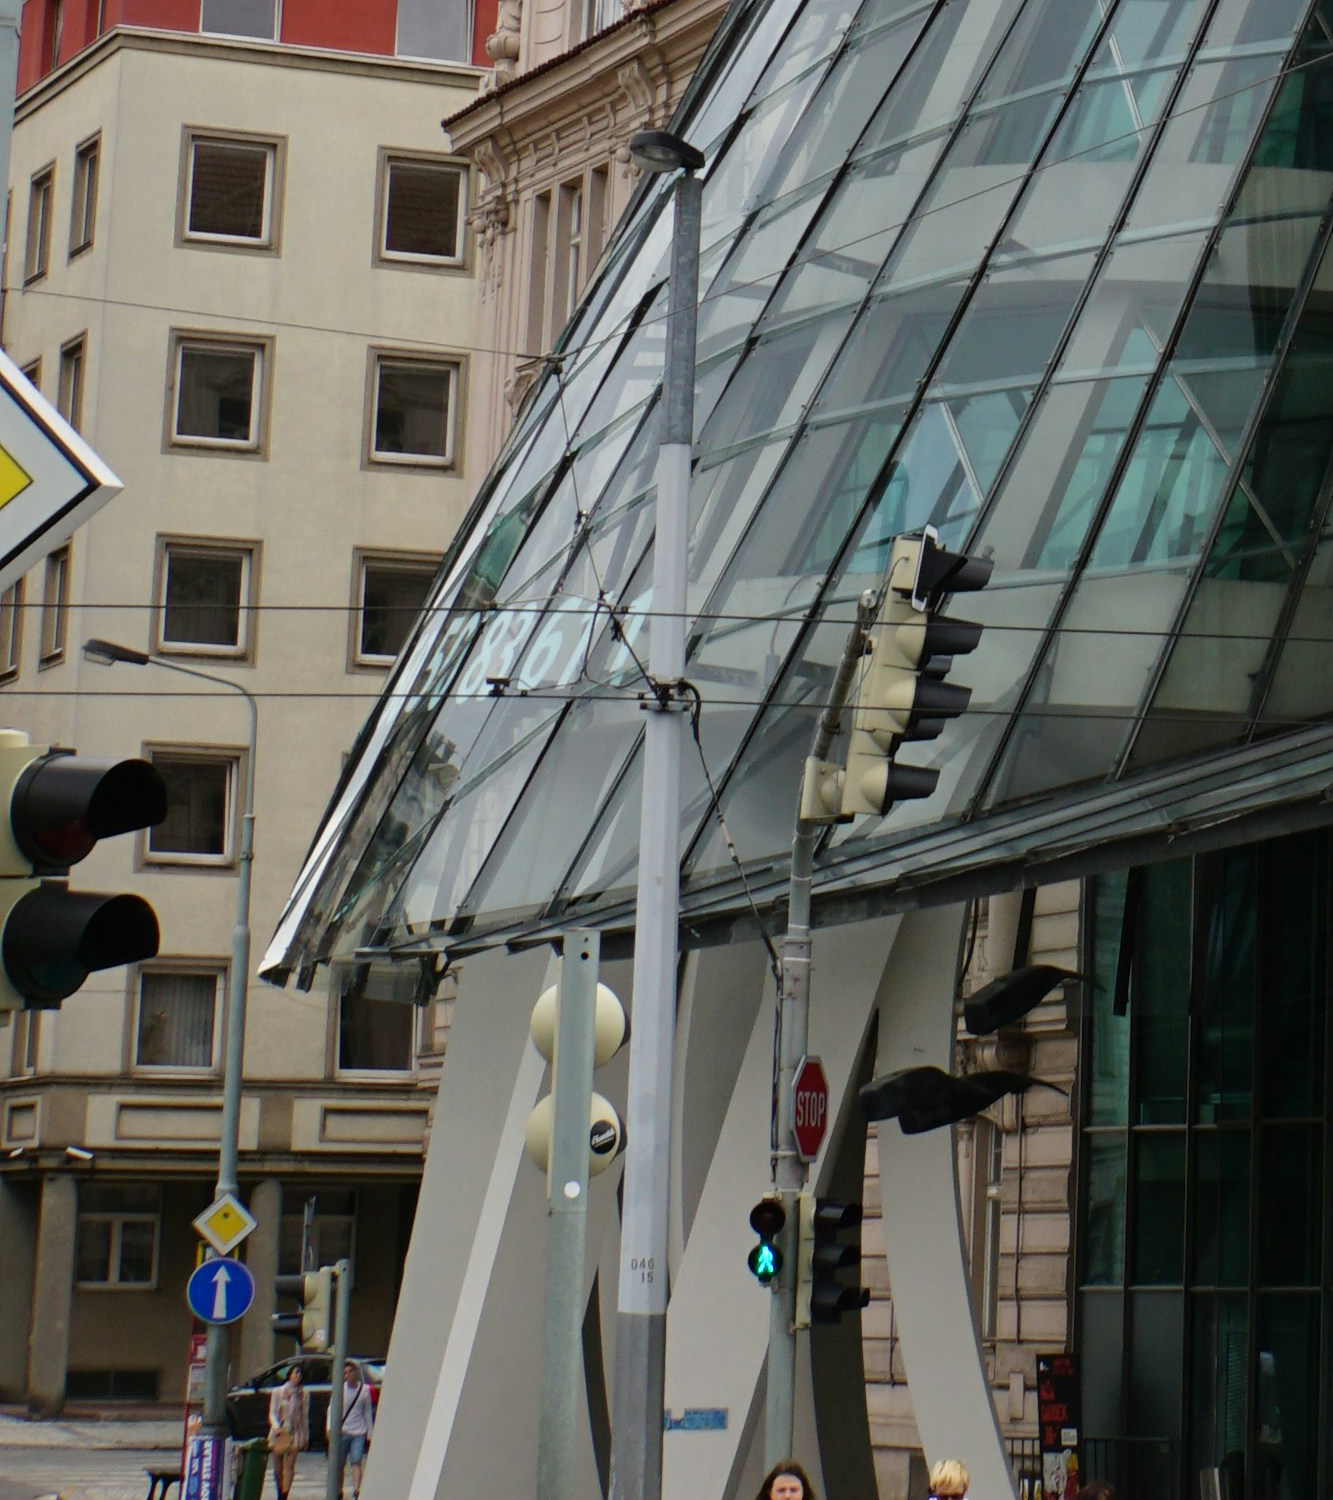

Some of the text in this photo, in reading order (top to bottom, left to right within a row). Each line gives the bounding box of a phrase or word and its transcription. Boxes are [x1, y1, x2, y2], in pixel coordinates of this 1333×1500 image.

[797, 1091, 825, 1127] STOP
[631, 1257, 655, 1270] 046
[641, 1271, 654, 1284] 15
